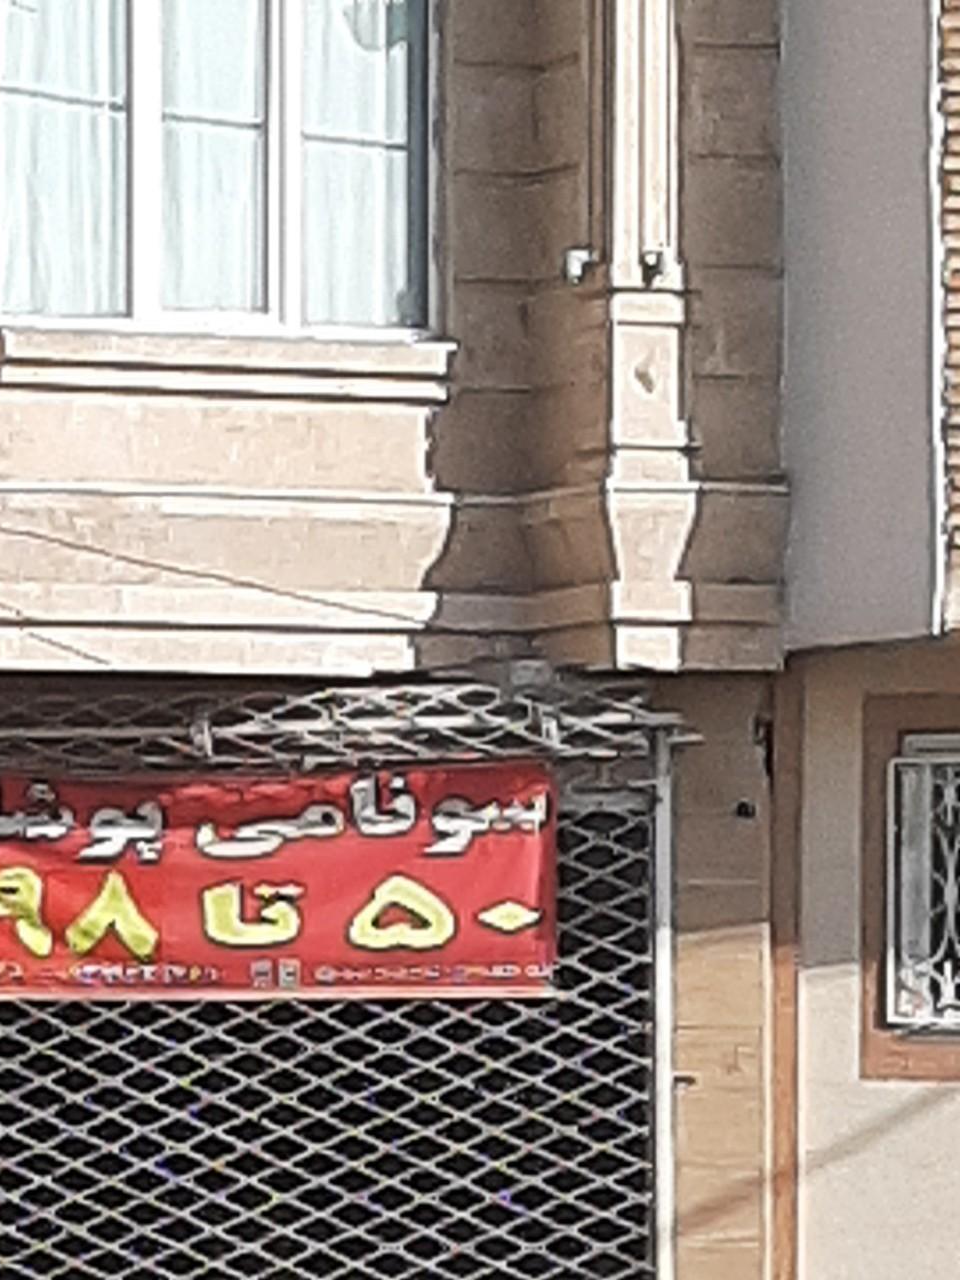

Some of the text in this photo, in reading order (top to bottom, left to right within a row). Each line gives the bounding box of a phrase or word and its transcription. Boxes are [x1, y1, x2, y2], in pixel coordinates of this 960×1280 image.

[195, 771, 549, 858] سونامی
[200, 880, 306, 948] تا
[346, 874, 540, 951] ۵۰
